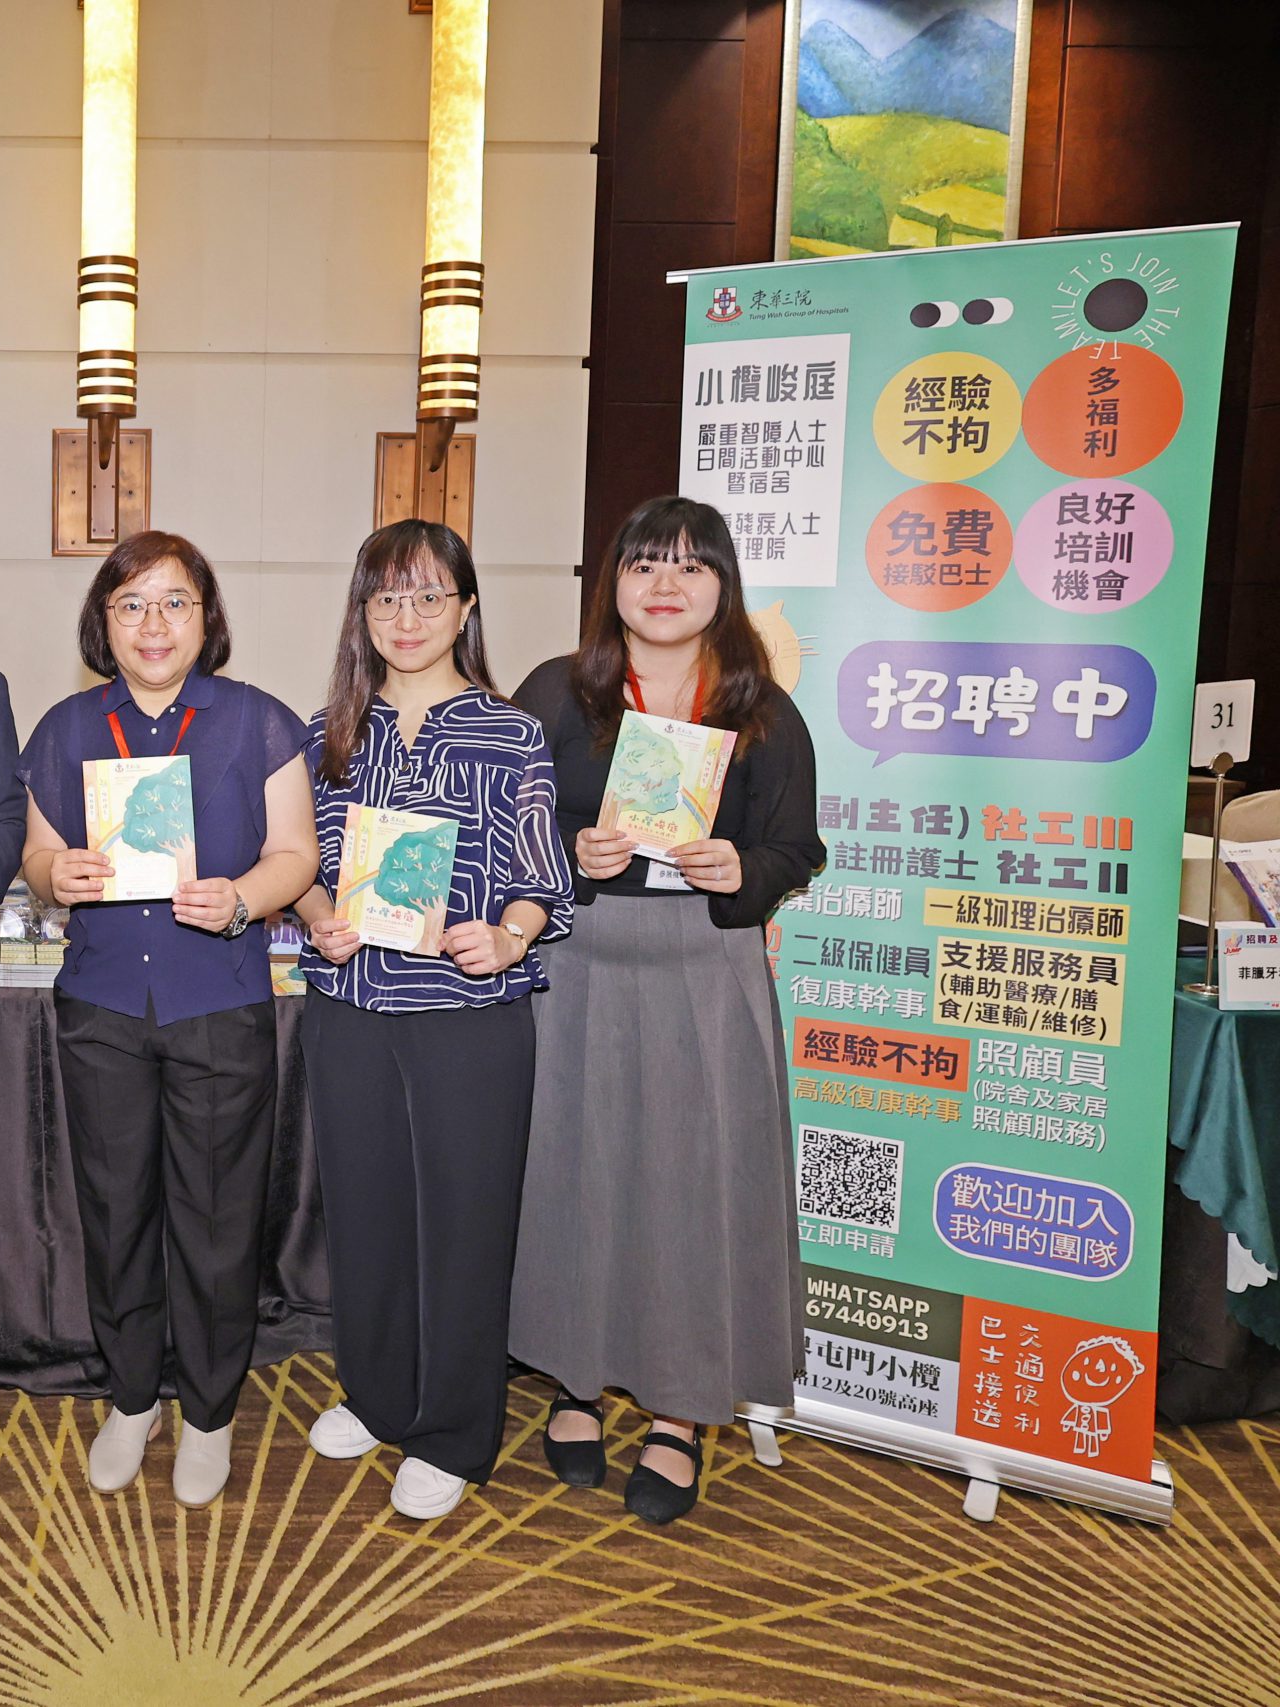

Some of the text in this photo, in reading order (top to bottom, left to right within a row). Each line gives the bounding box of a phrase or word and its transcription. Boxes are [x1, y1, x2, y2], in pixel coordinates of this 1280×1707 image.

[1052, 252, 1114, 310] LET'S
[1127, 252, 1180, 294] JOIN
[750, 289, 812, 310] 東華三院
[784, 310, 806, 319] Group
[815, 307, 849, 315] Hospitals
[1134, 306, 1181, 349] THE
[695, 361, 836, 406] 小欖峻庭
[904, 374, 992, 413] 經驗
[698, 419, 827, 446] 嚴重智障人士
[1083, 366, 1121, 459] 多福利
[902, 416, 990, 456] 不拘
[697, 445, 825, 472] 日間活動中心
[727, 471, 790, 495] 暨宿舍
[1056, 491, 1135, 526] 良好
[886, 508, 994, 556] 免費
[1054, 531, 1134, 564] 培訓
[883, 562, 992, 587] 接駁巴士
[1052, 568, 1130, 601] 機會
[866, 662, 1129, 739] 招聘中
[1210, 702, 1235, 730] 31
[817, 795, 969, 839] 副主任)
[834, 841, 979, 881] 註冊護士
[930, 895, 1125, 938] 一級物理治療師
[793, 932, 931, 979] 二級保健員
[1246, 934, 1278, 945] 招聘及
[940, 940, 1119, 986] 支援服務員
[1238, 966, 1280, 980] 菲臘牙
[790, 974, 928, 1019] 復康幹事
[940, 973, 1099, 1012] (輔助醫療/膳
[938, 998, 1108, 1041] 食/運輸/維修)
[803, 1028, 959, 1080] 經驗不拘
[976, 1037, 1108, 1091] 照顧員
[793, 1076, 962, 1123] 高級復康幹事
[972, 1079, 1108, 1119] (院舍及家居
[972, 1104, 1106, 1152] 照顧服務)
[951, 1172, 1119, 1236] 歡迎加入
[798, 1219, 896, 1259] 立即申請
[949, 1212, 1118, 1269] 我們的團隊
[806, 1277, 930, 1318] WHATSAPP
[805, 1299, 929, 1341] 67440913
[972, 1315, 1006, 1429] 巴士接送
[1015, 1323, 1044, 1436] 交通便利
